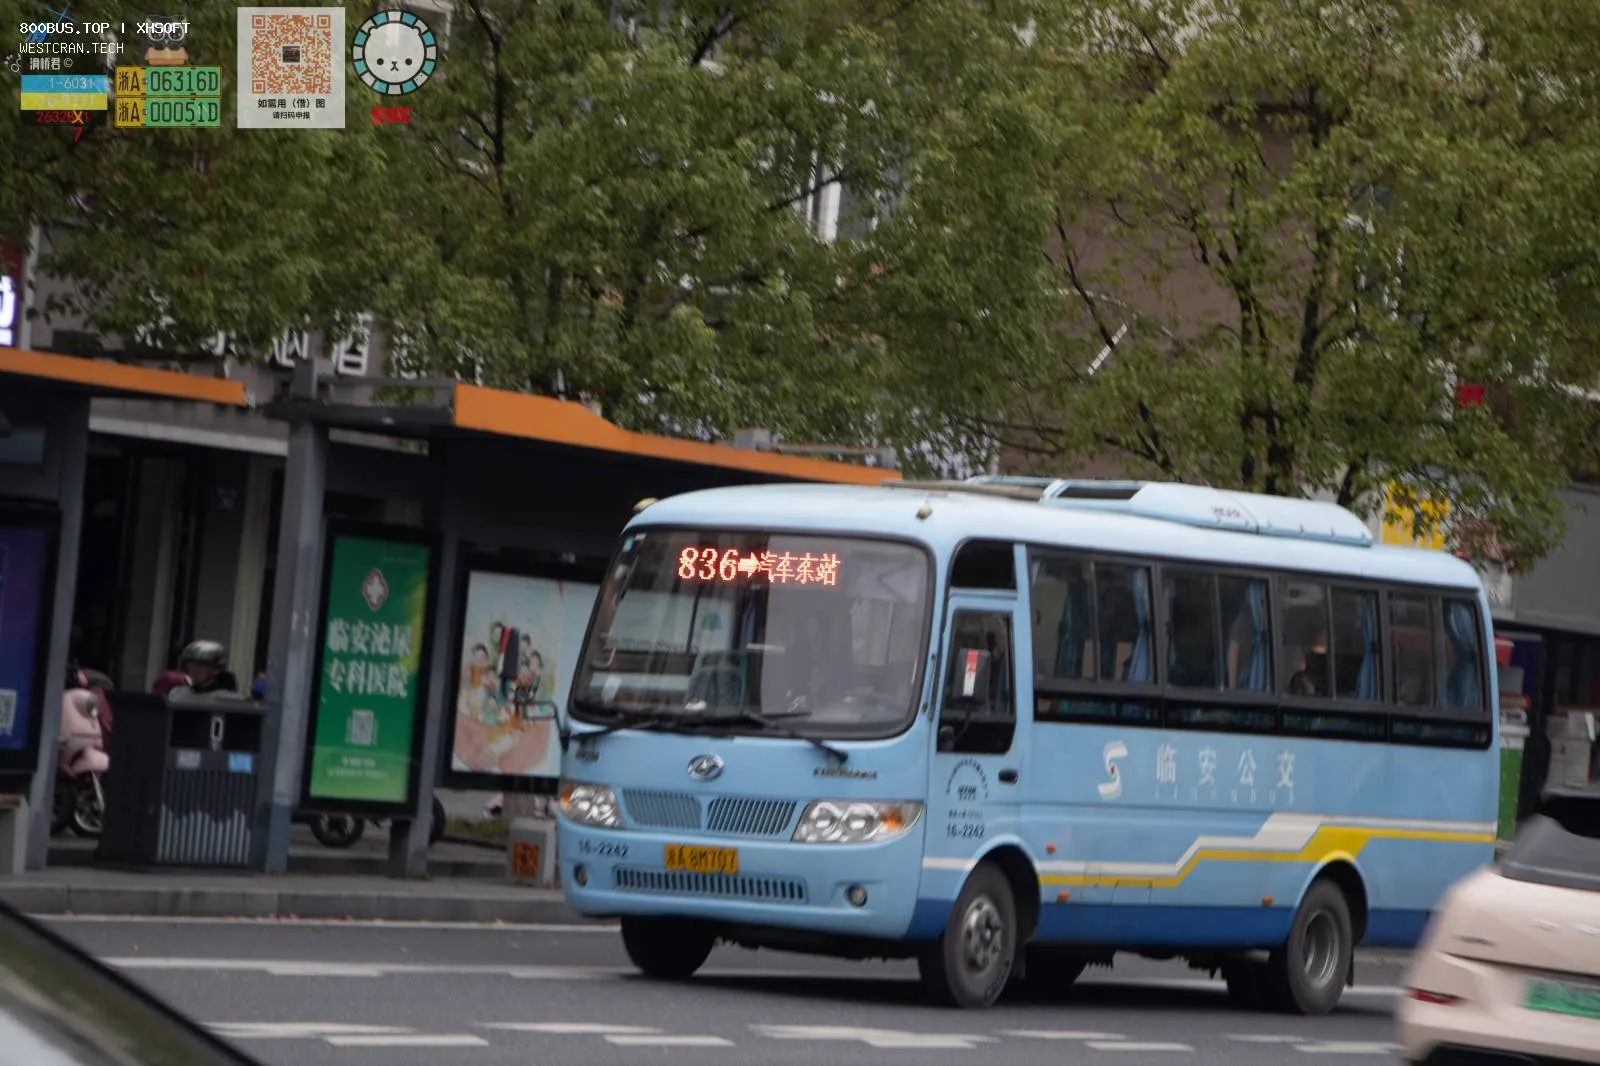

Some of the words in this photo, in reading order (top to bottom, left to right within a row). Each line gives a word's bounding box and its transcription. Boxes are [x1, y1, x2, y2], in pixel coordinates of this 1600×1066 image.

[677, 546, 739, 581] 836
[758, 549, 841, 587] 汽车东站
[1156, 742, 1296, 789] 临安公交
